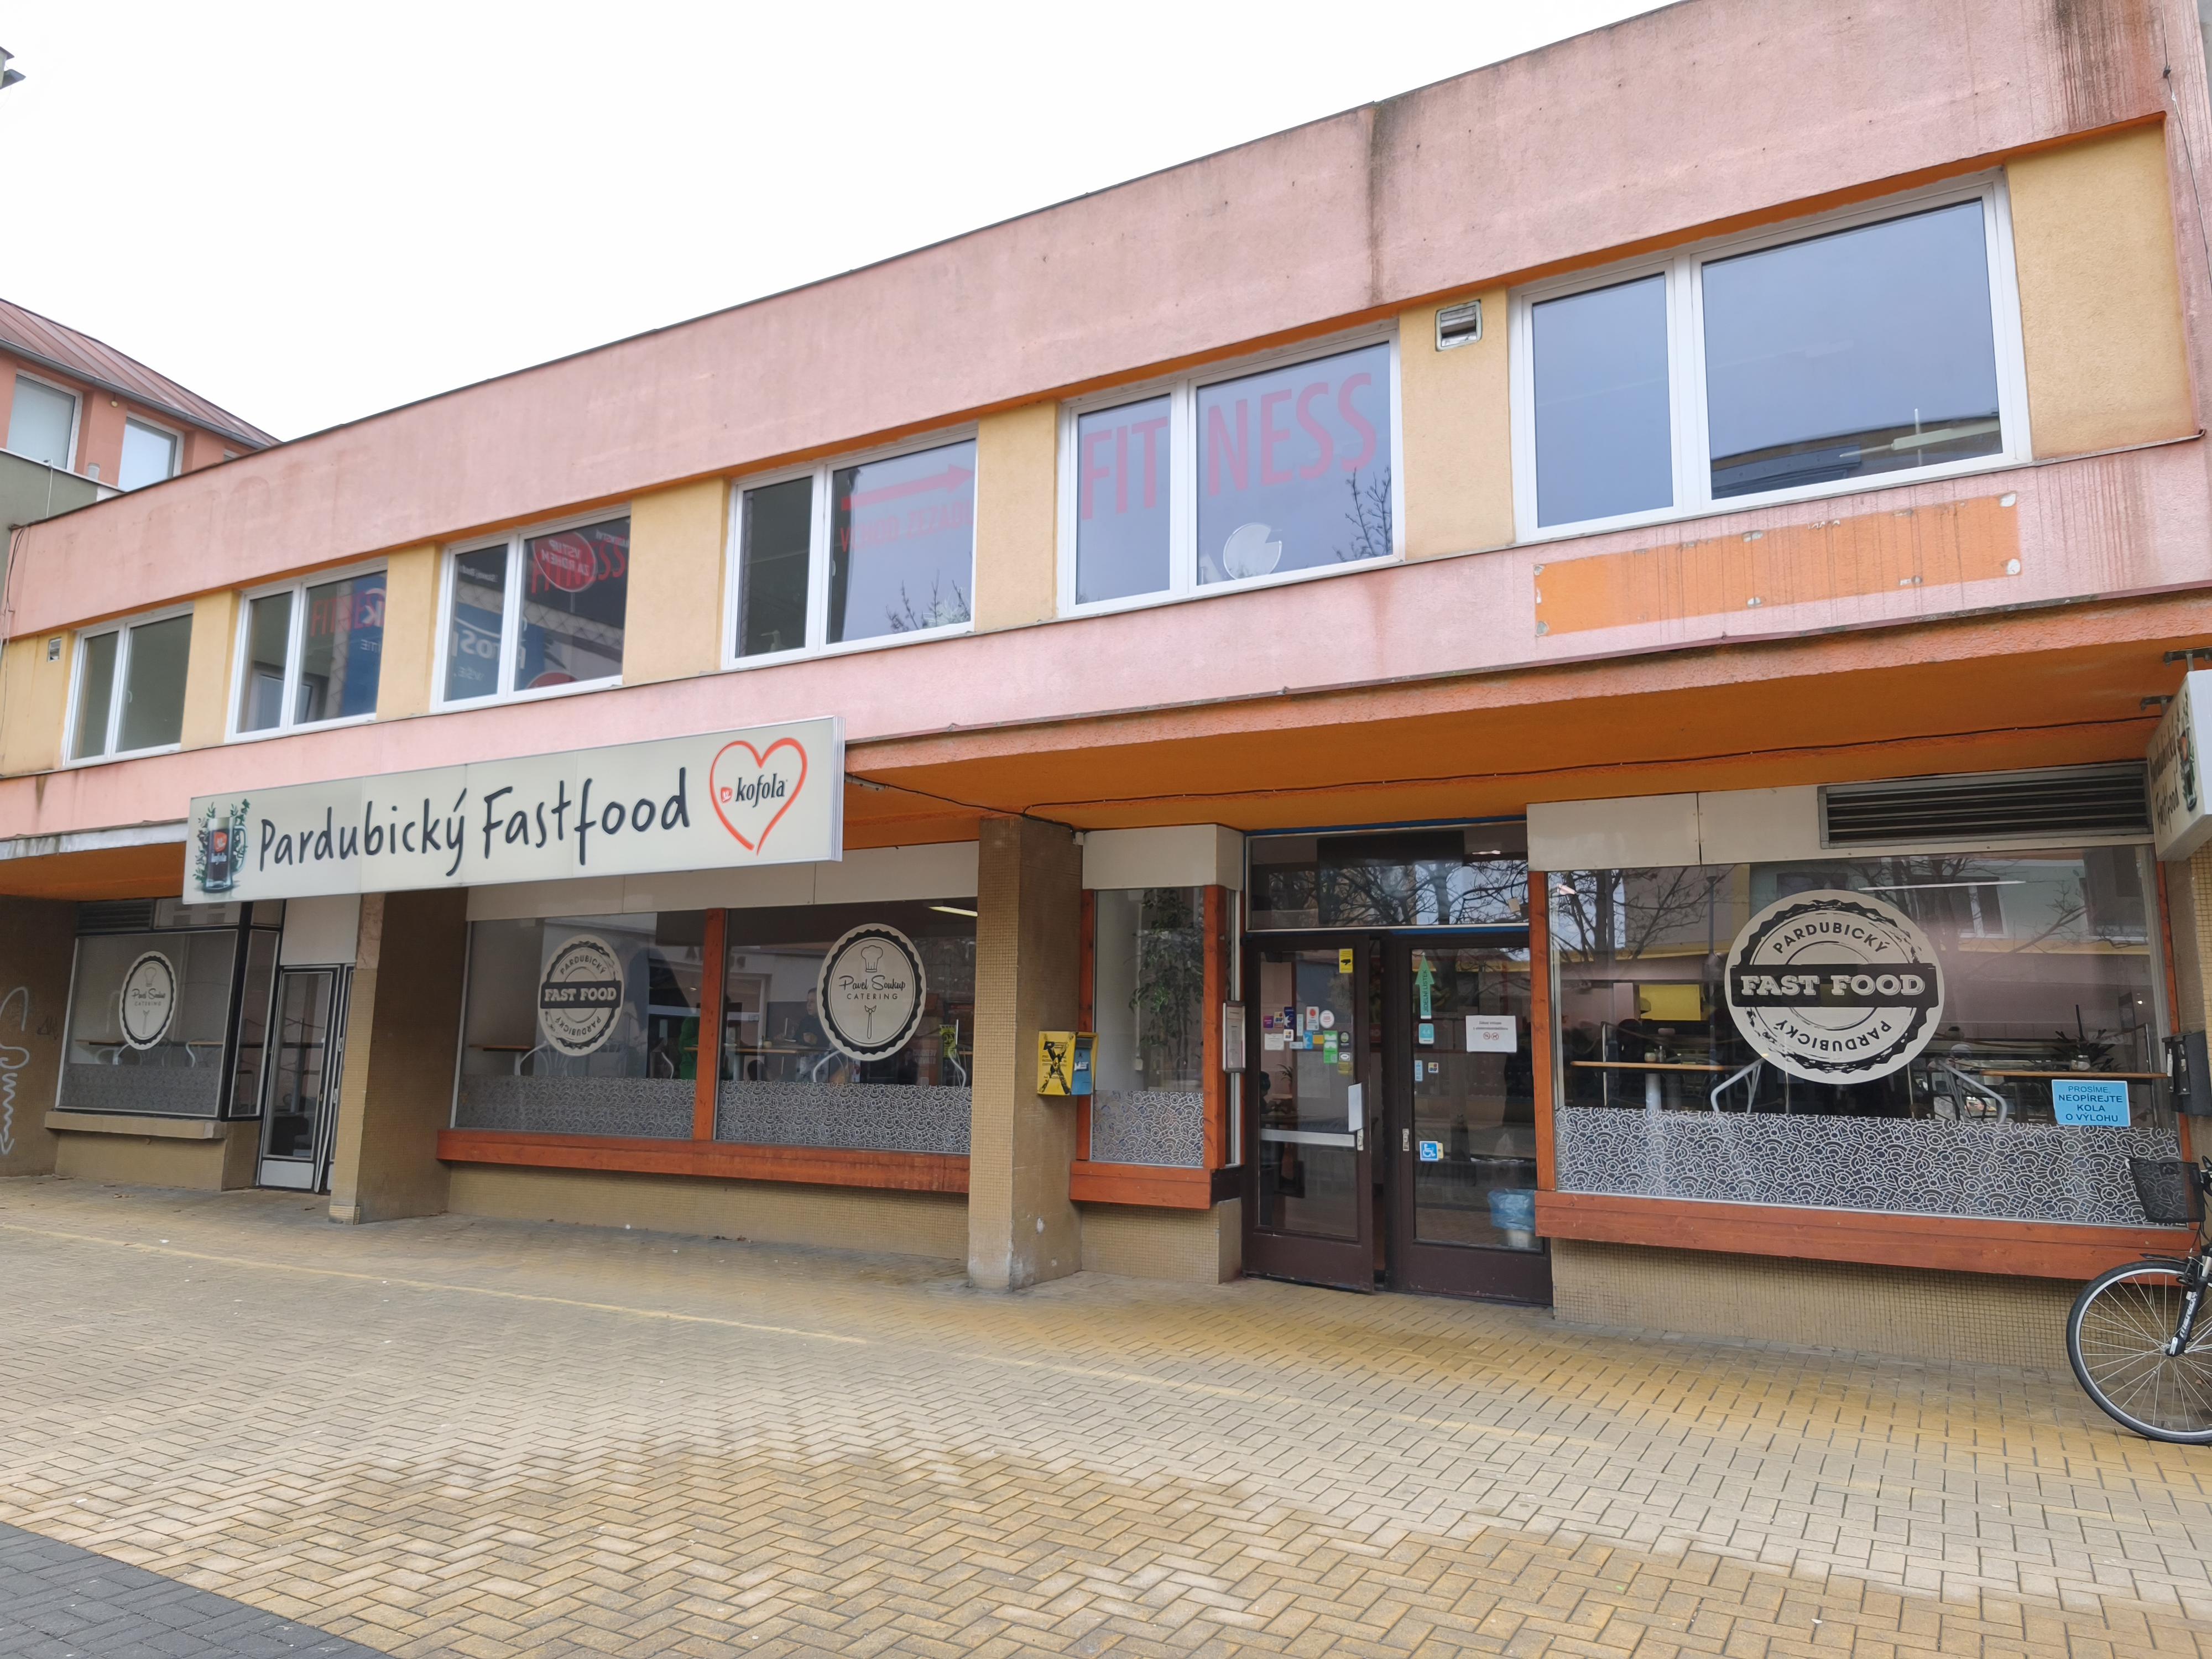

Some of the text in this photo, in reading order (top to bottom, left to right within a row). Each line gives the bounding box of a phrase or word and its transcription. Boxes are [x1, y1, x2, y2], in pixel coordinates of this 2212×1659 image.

[735, 773, 786, 808] kofola
[259, 766, 690, 877] Pardubický Fastfood
[1773, 922, 1890, 953] PARDUBICKÝ
[560, 955, 607, 975] PARDUBICKÝ
[839, 975, 868, 991] Pavel
[1740, 974, 1925, 996] FAST FOOD
[544, 987, 617, 1002] FAST FOOD
[555, 1016, 602, 1036] PARDUBICKÝ
[1773, 1020, 1892, 1052] PARDUBICKÝ
[2059, 1093, 2123, 1103] NEOPÍREJTE
[2068, 1086, 2111, 1094] PROSÍME,
[2076, 1112, 2118, 1122] VÝLOHU
